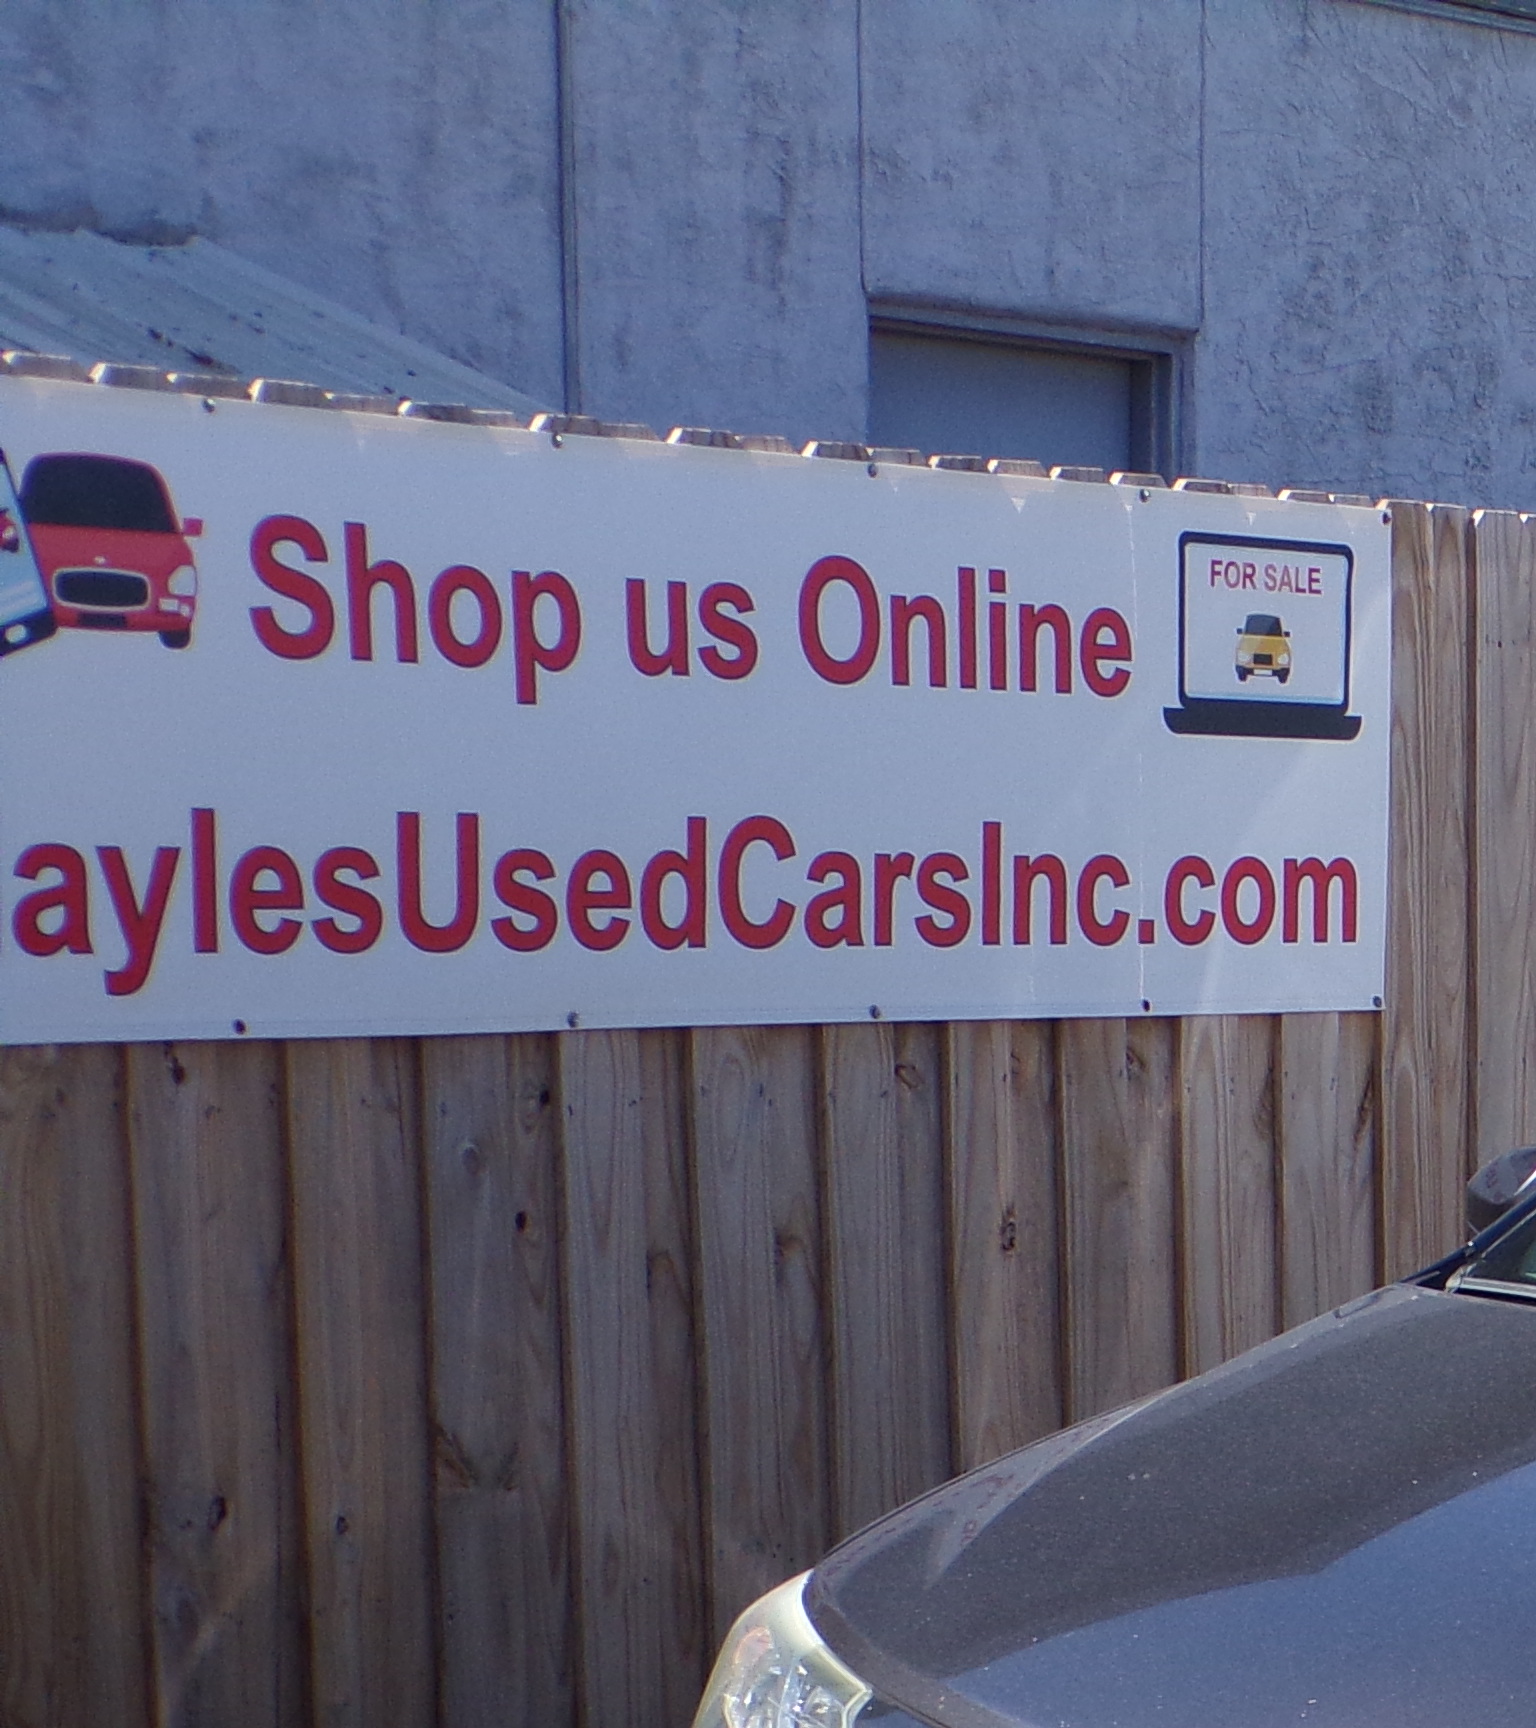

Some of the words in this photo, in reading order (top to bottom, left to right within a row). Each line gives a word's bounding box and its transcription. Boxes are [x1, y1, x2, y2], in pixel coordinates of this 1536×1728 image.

[248, 514, 582, 704] Shop
[625, 577, 760, 680] us
[799, 554, 1134, 697] Online
[1210, 559, 1257, 589] FOR
[1264, 563, 1322, 594] SALE
[0, 807, 1358, 997] aylesUsedCarsInc.com
